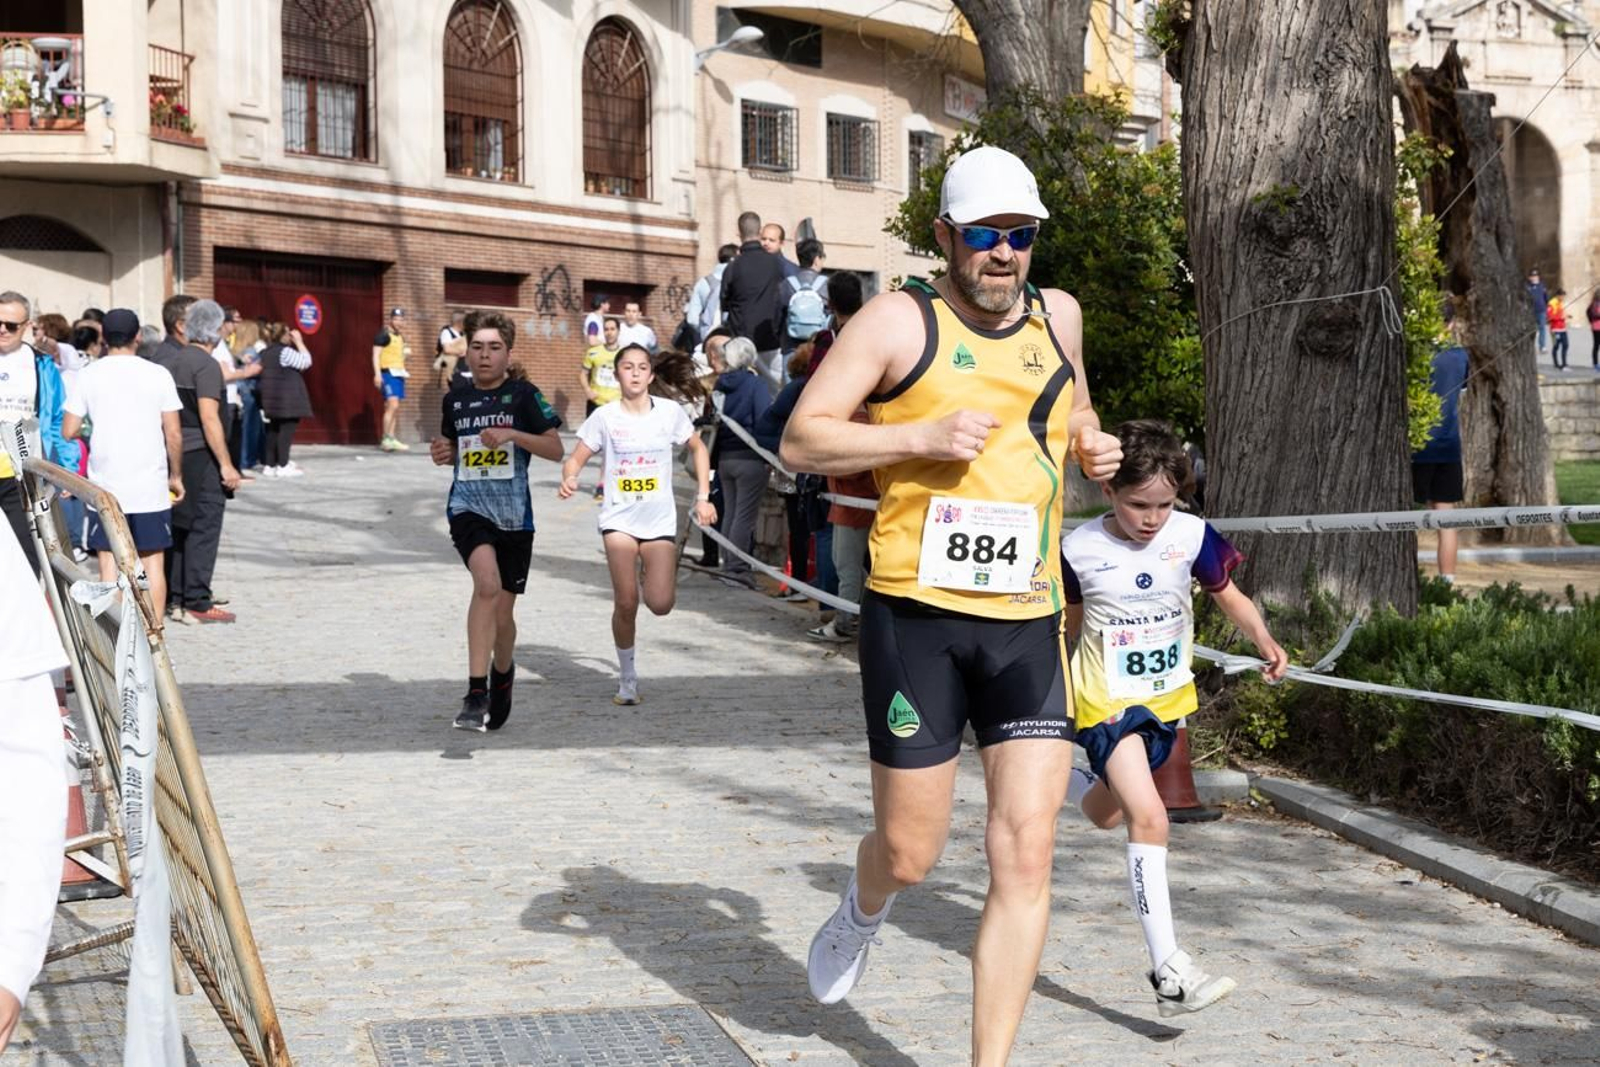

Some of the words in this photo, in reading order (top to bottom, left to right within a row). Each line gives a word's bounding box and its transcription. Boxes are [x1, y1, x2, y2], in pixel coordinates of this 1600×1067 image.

[473, 411, 514, 427] ANTÓN
[463, 450, 509, 467] 1242
[622, 478, 655, 492] 835
[1516, 512, 1553, 524] DEPORTES
[946, 532, 1018, 565] 884
[1008, 593, 1047, 604] JACARSA
[1109, 616, 1150, 626] SANTA
[1126, 643, 1178, 676] 838
[889, 707, 915, 724] Jaén
[1020, 720, 1067, 728] HYUNDAI
[1009, 728, 1062, 737] JACARSA
